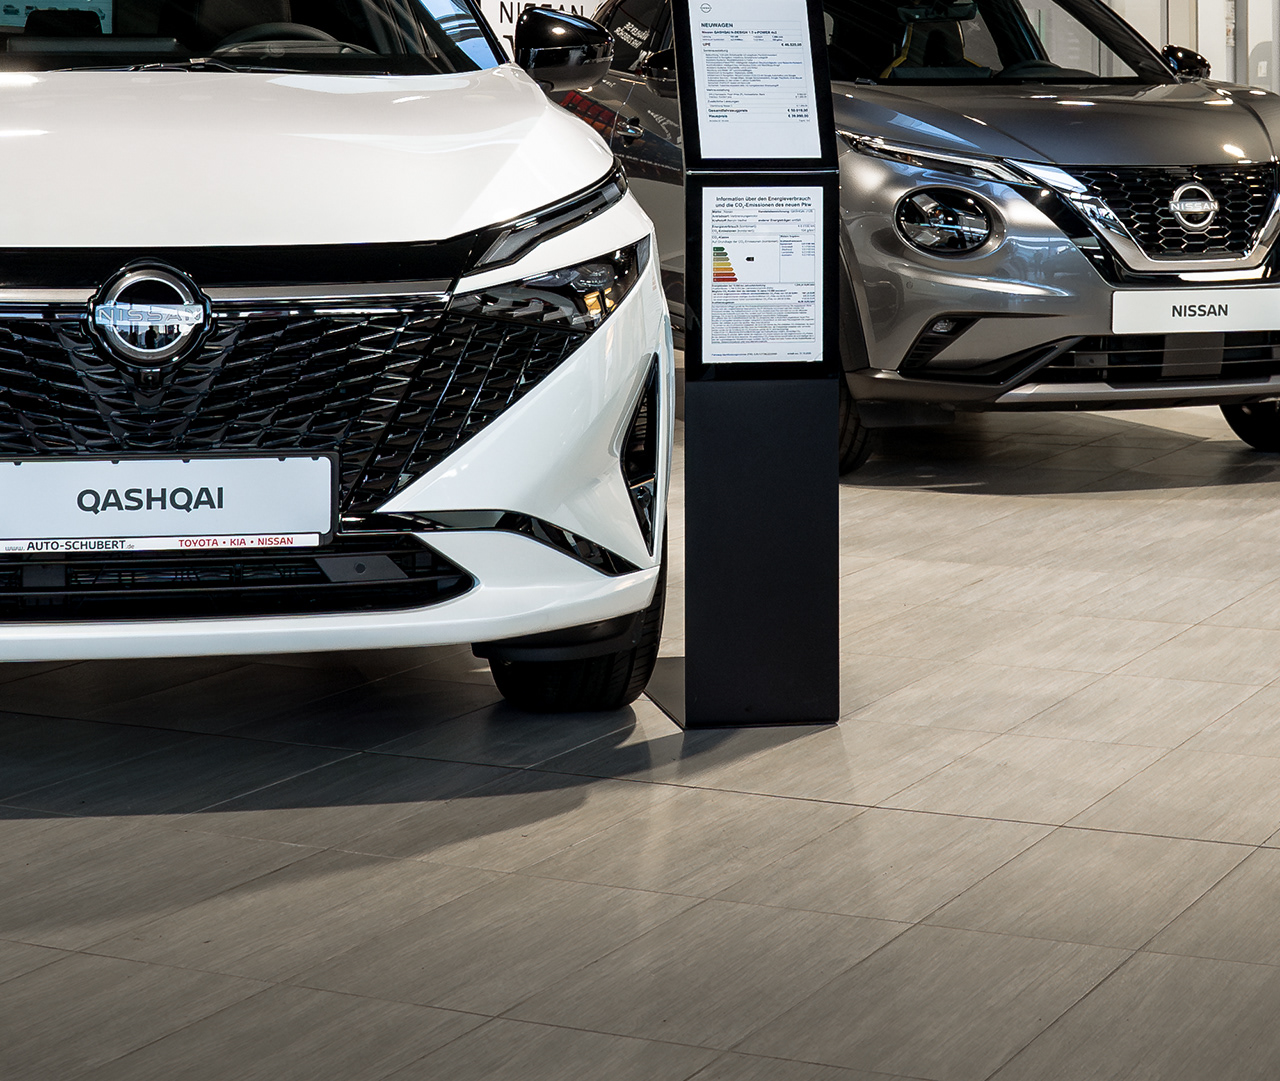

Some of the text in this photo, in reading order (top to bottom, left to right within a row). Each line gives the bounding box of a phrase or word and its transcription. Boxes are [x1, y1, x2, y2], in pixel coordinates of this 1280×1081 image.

[1171, 202, 1218, 211] NISSAN
[98, 308, 201, 321] NISSAN
[1172, 304, 1228, 317] NISSAN
[76, 486, 224, 515] QASHQAI
[178, 538, 219, 548] TOYOTA
[230, 538, 247, 547] KIA
[257, 536, 294, 547] NISSAN
